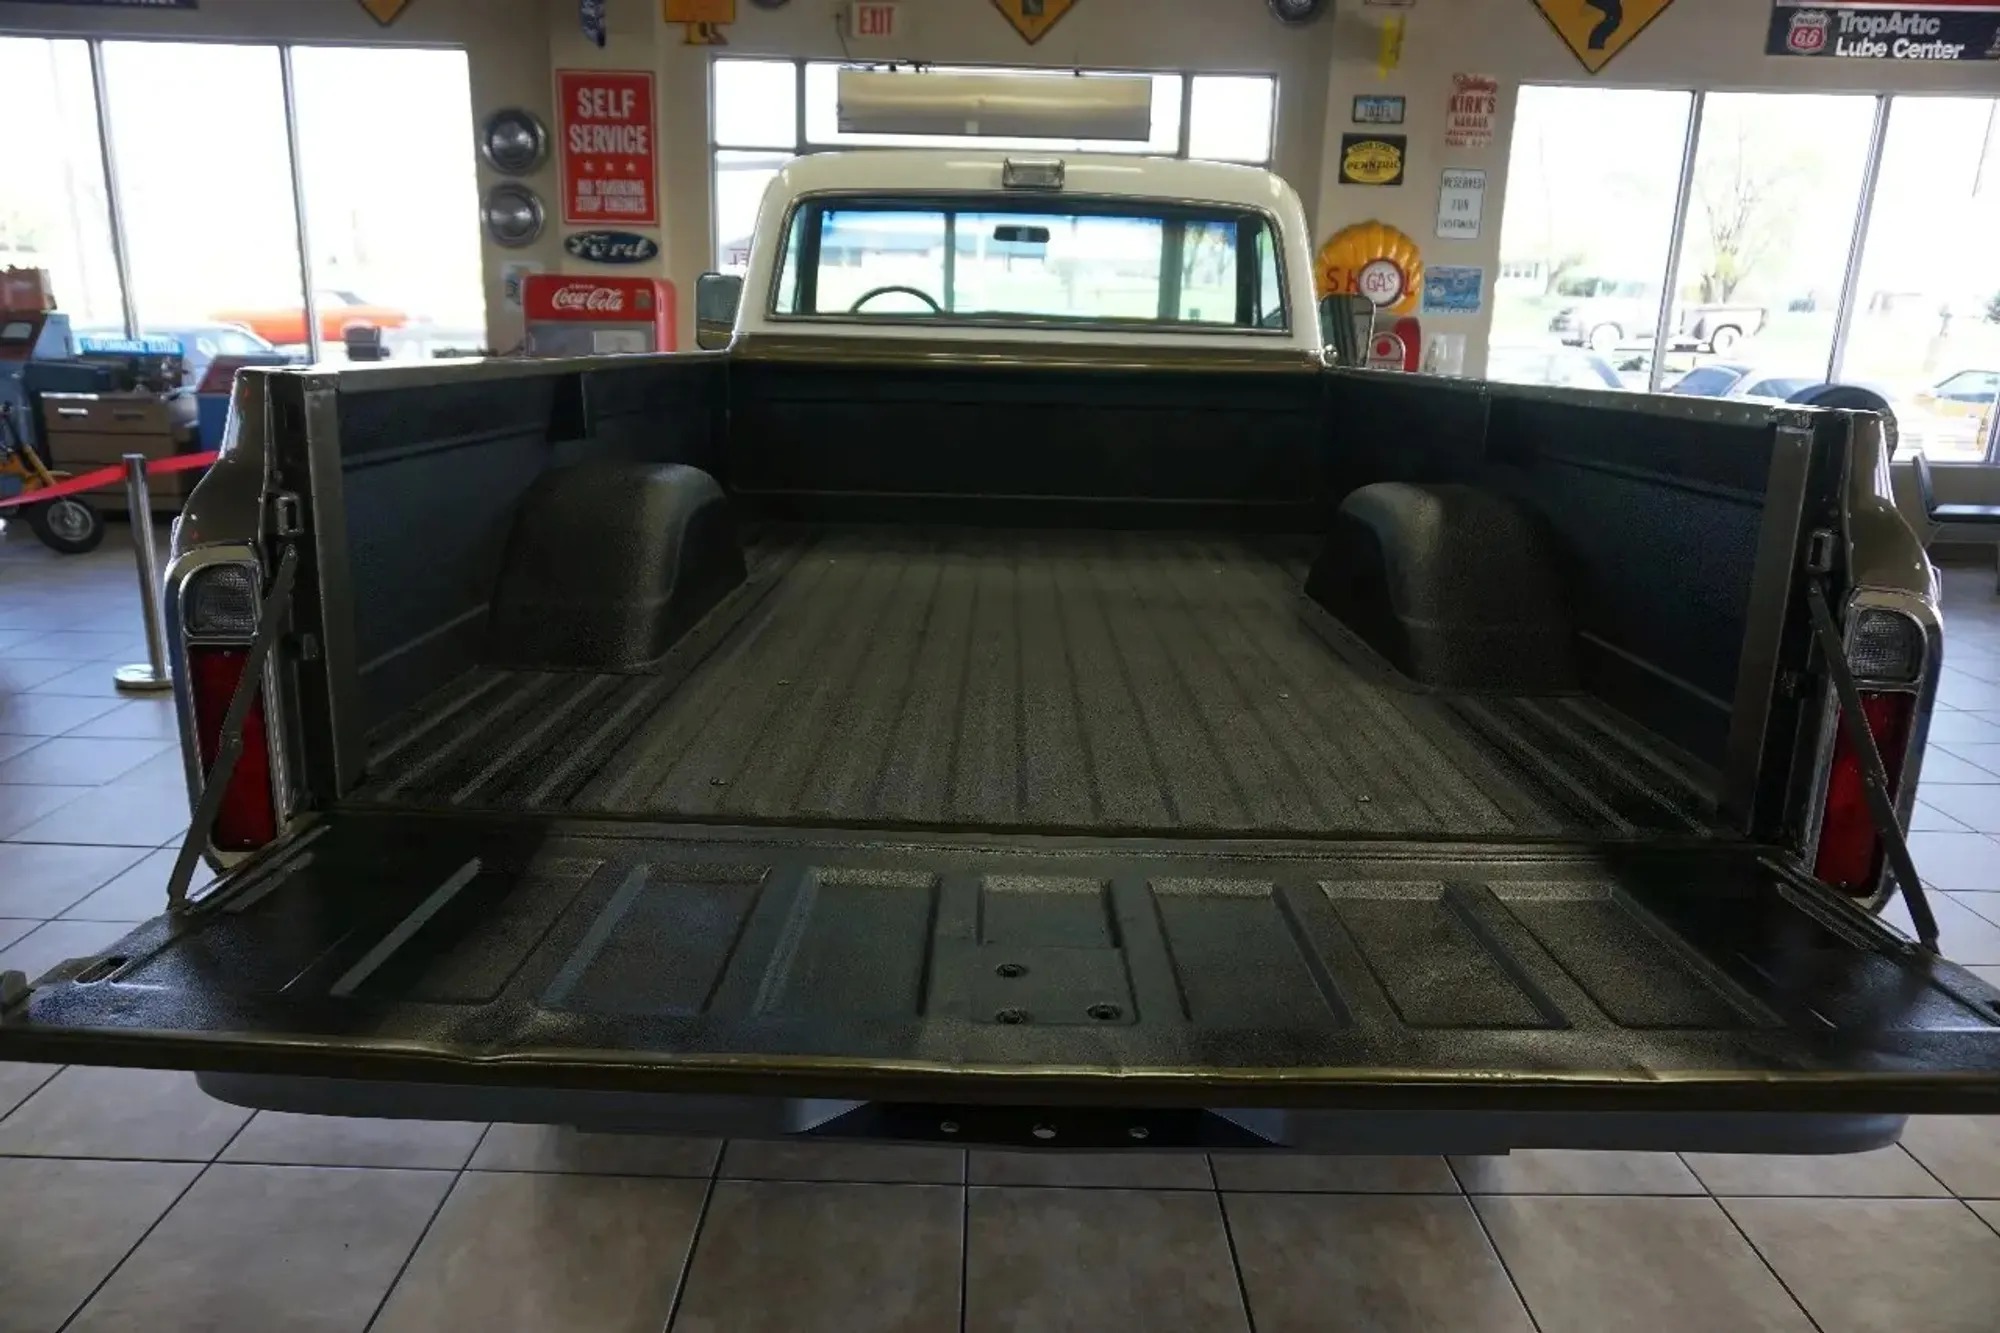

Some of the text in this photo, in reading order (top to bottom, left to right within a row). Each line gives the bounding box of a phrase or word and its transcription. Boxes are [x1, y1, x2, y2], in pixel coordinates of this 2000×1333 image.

[858, 6, 894, 35] EXIT
[1837, 11, 1941, 38] TropArtic
[1795, 29, 1820, 46] 66
[1836, 37, 1965, 59] Lube Center
[577, 88, 635, 118] SELF
[570, 124, 649, 154] SERVICE
[570, 234, 651, 258] Ford
[1367, 271, 1396, 292] GAS
[552, 287, 624, 311] Coca-Cola
